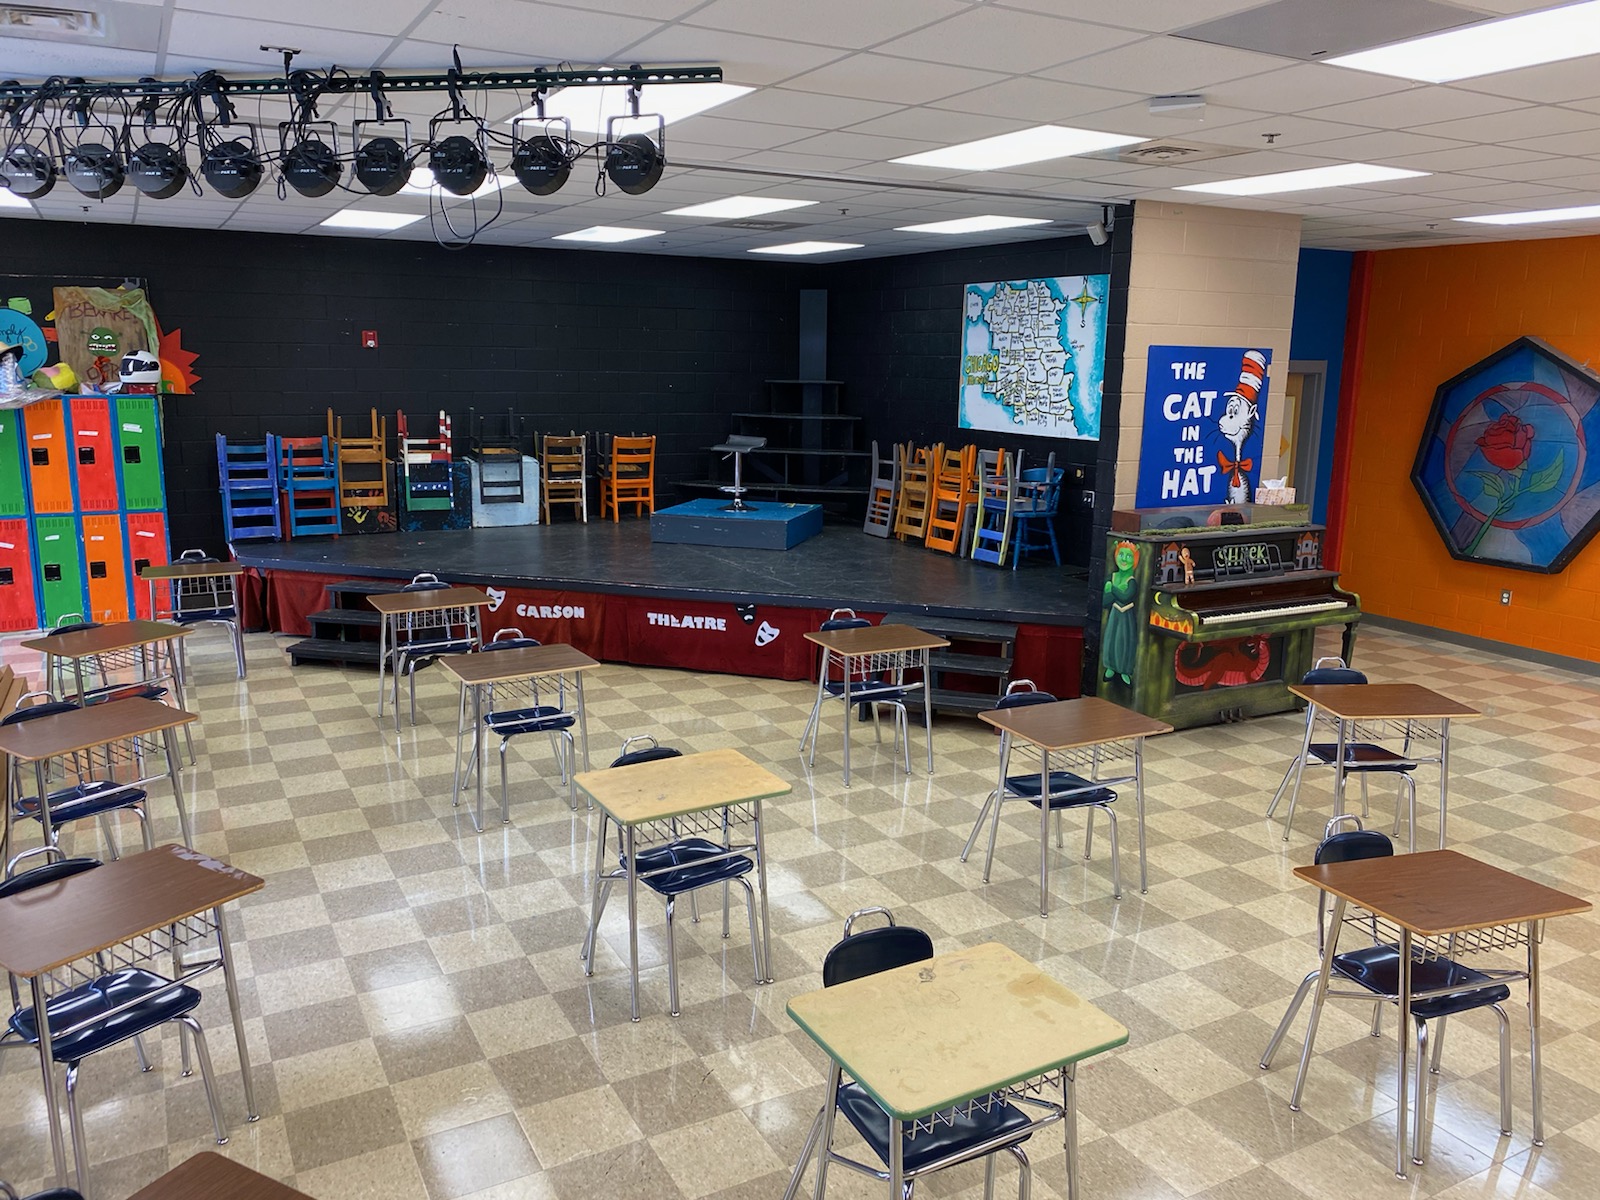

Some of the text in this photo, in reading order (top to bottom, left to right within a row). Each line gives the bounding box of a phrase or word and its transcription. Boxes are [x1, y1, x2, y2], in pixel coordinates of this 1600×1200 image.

[1082, 276, 1089, 285] N
[1080, 320, 1086, 328] S
[965, 354, 1000, 374] CHICAGO
[1171, 361, 1207, 380] THE
[1163, 391, 1217, 421] CAT
[1181, 425, 1200, 442] IN
[1173, 445, 1204, 464] THE
[1161, 465, 1217, 500] HAT
[515, 603, 727, 631] CARSON THEATRE
